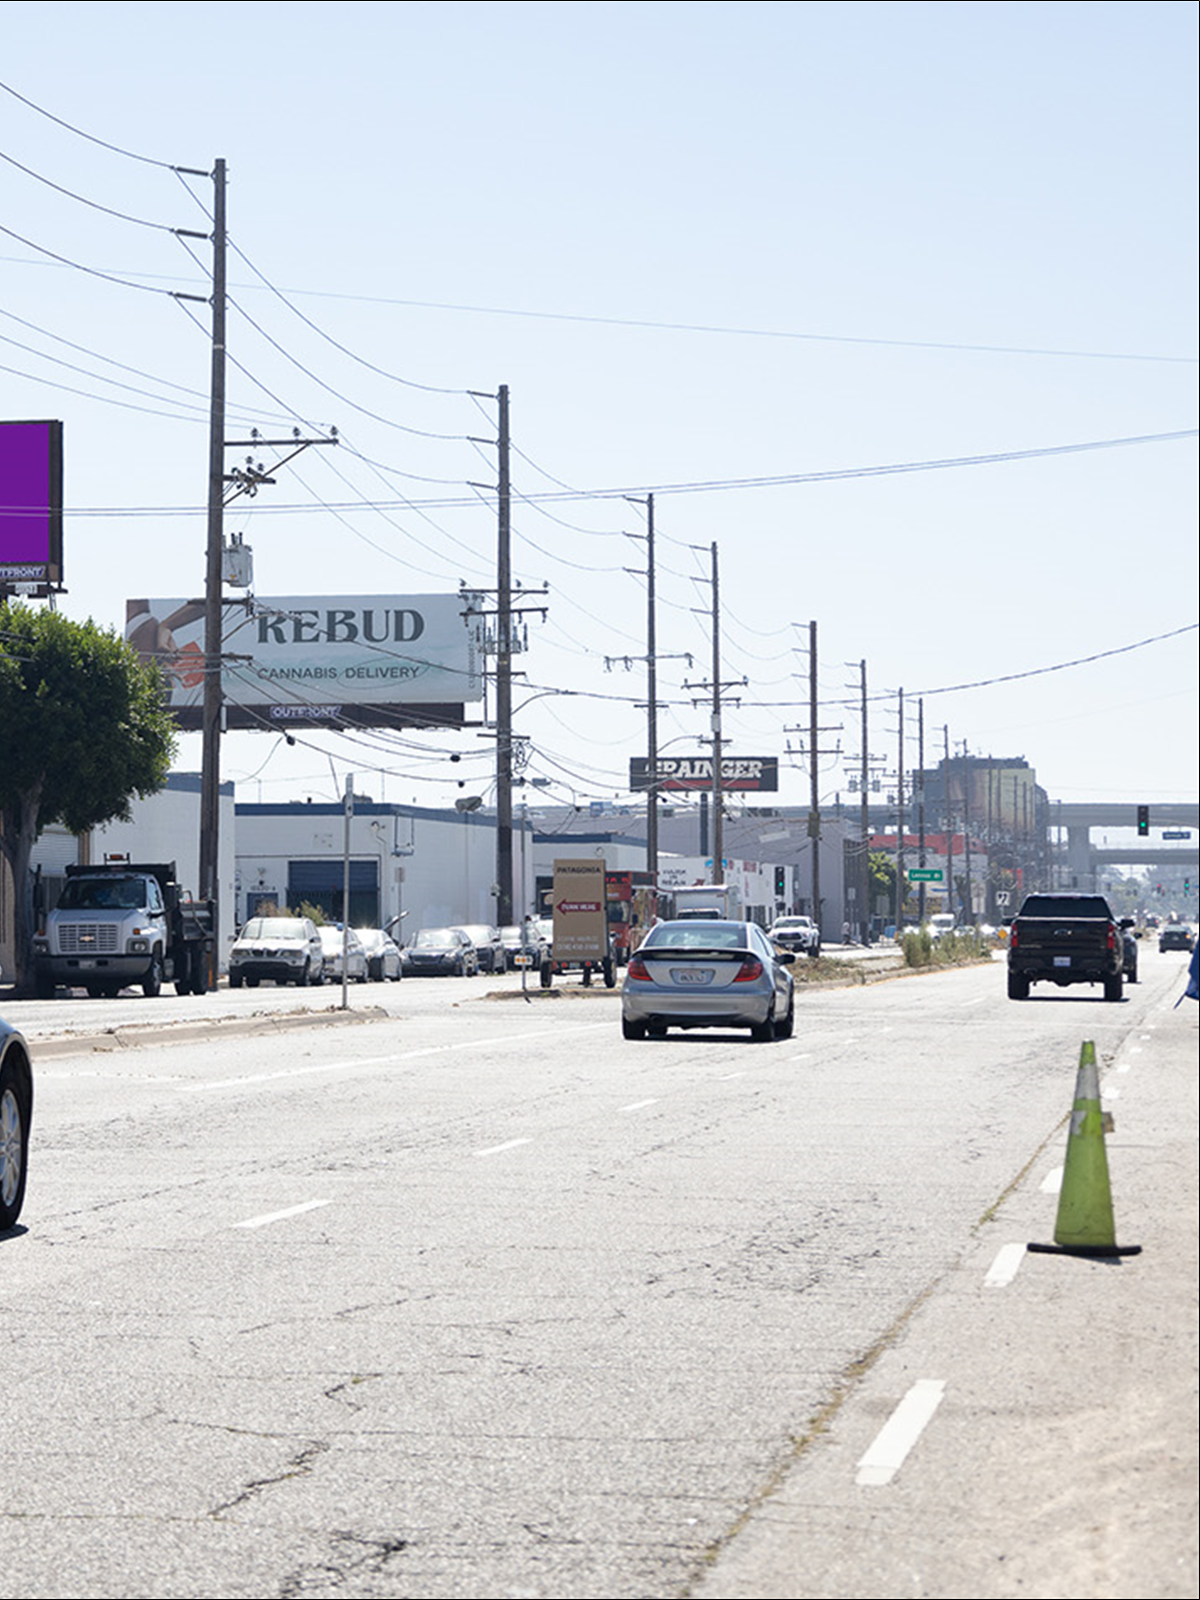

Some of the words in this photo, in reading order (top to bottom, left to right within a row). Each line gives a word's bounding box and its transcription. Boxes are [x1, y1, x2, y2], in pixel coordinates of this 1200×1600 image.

[257, 609, 425, 644] REBUD
[257, 668, 338, 680] CANNABIS
[344, 666, 420, 679] DELIVERY
[272, 706, 339, 718] OUTFRONT
